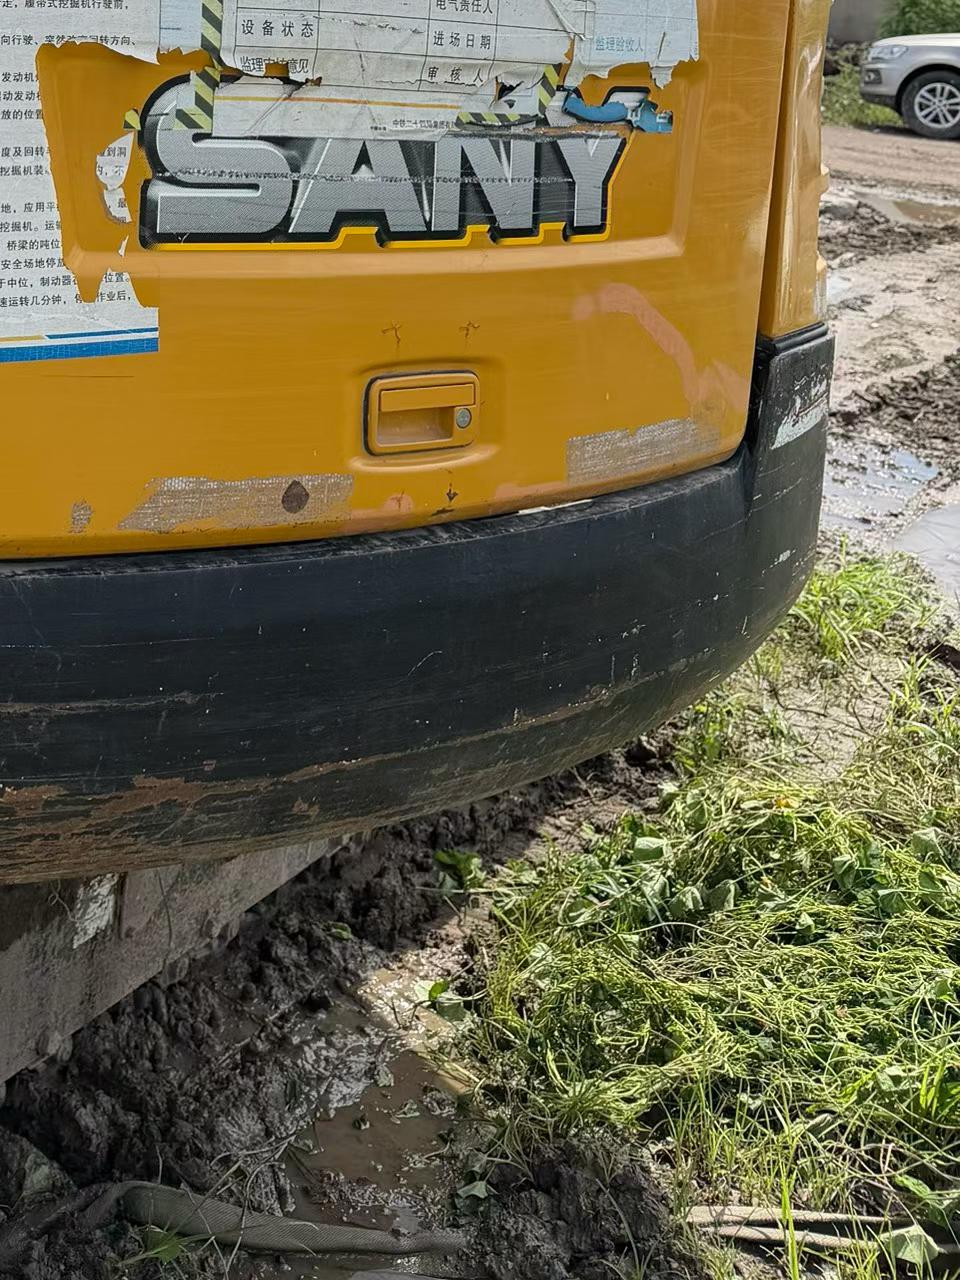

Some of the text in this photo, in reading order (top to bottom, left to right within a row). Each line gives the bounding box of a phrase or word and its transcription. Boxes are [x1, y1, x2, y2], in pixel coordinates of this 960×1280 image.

[241, 18, 315, 39] 设备状态
[433, 29, 492, 51] 进场日期
[427, 65, 485, 83] 审核人
[142, 78, 644, 246] SANY
